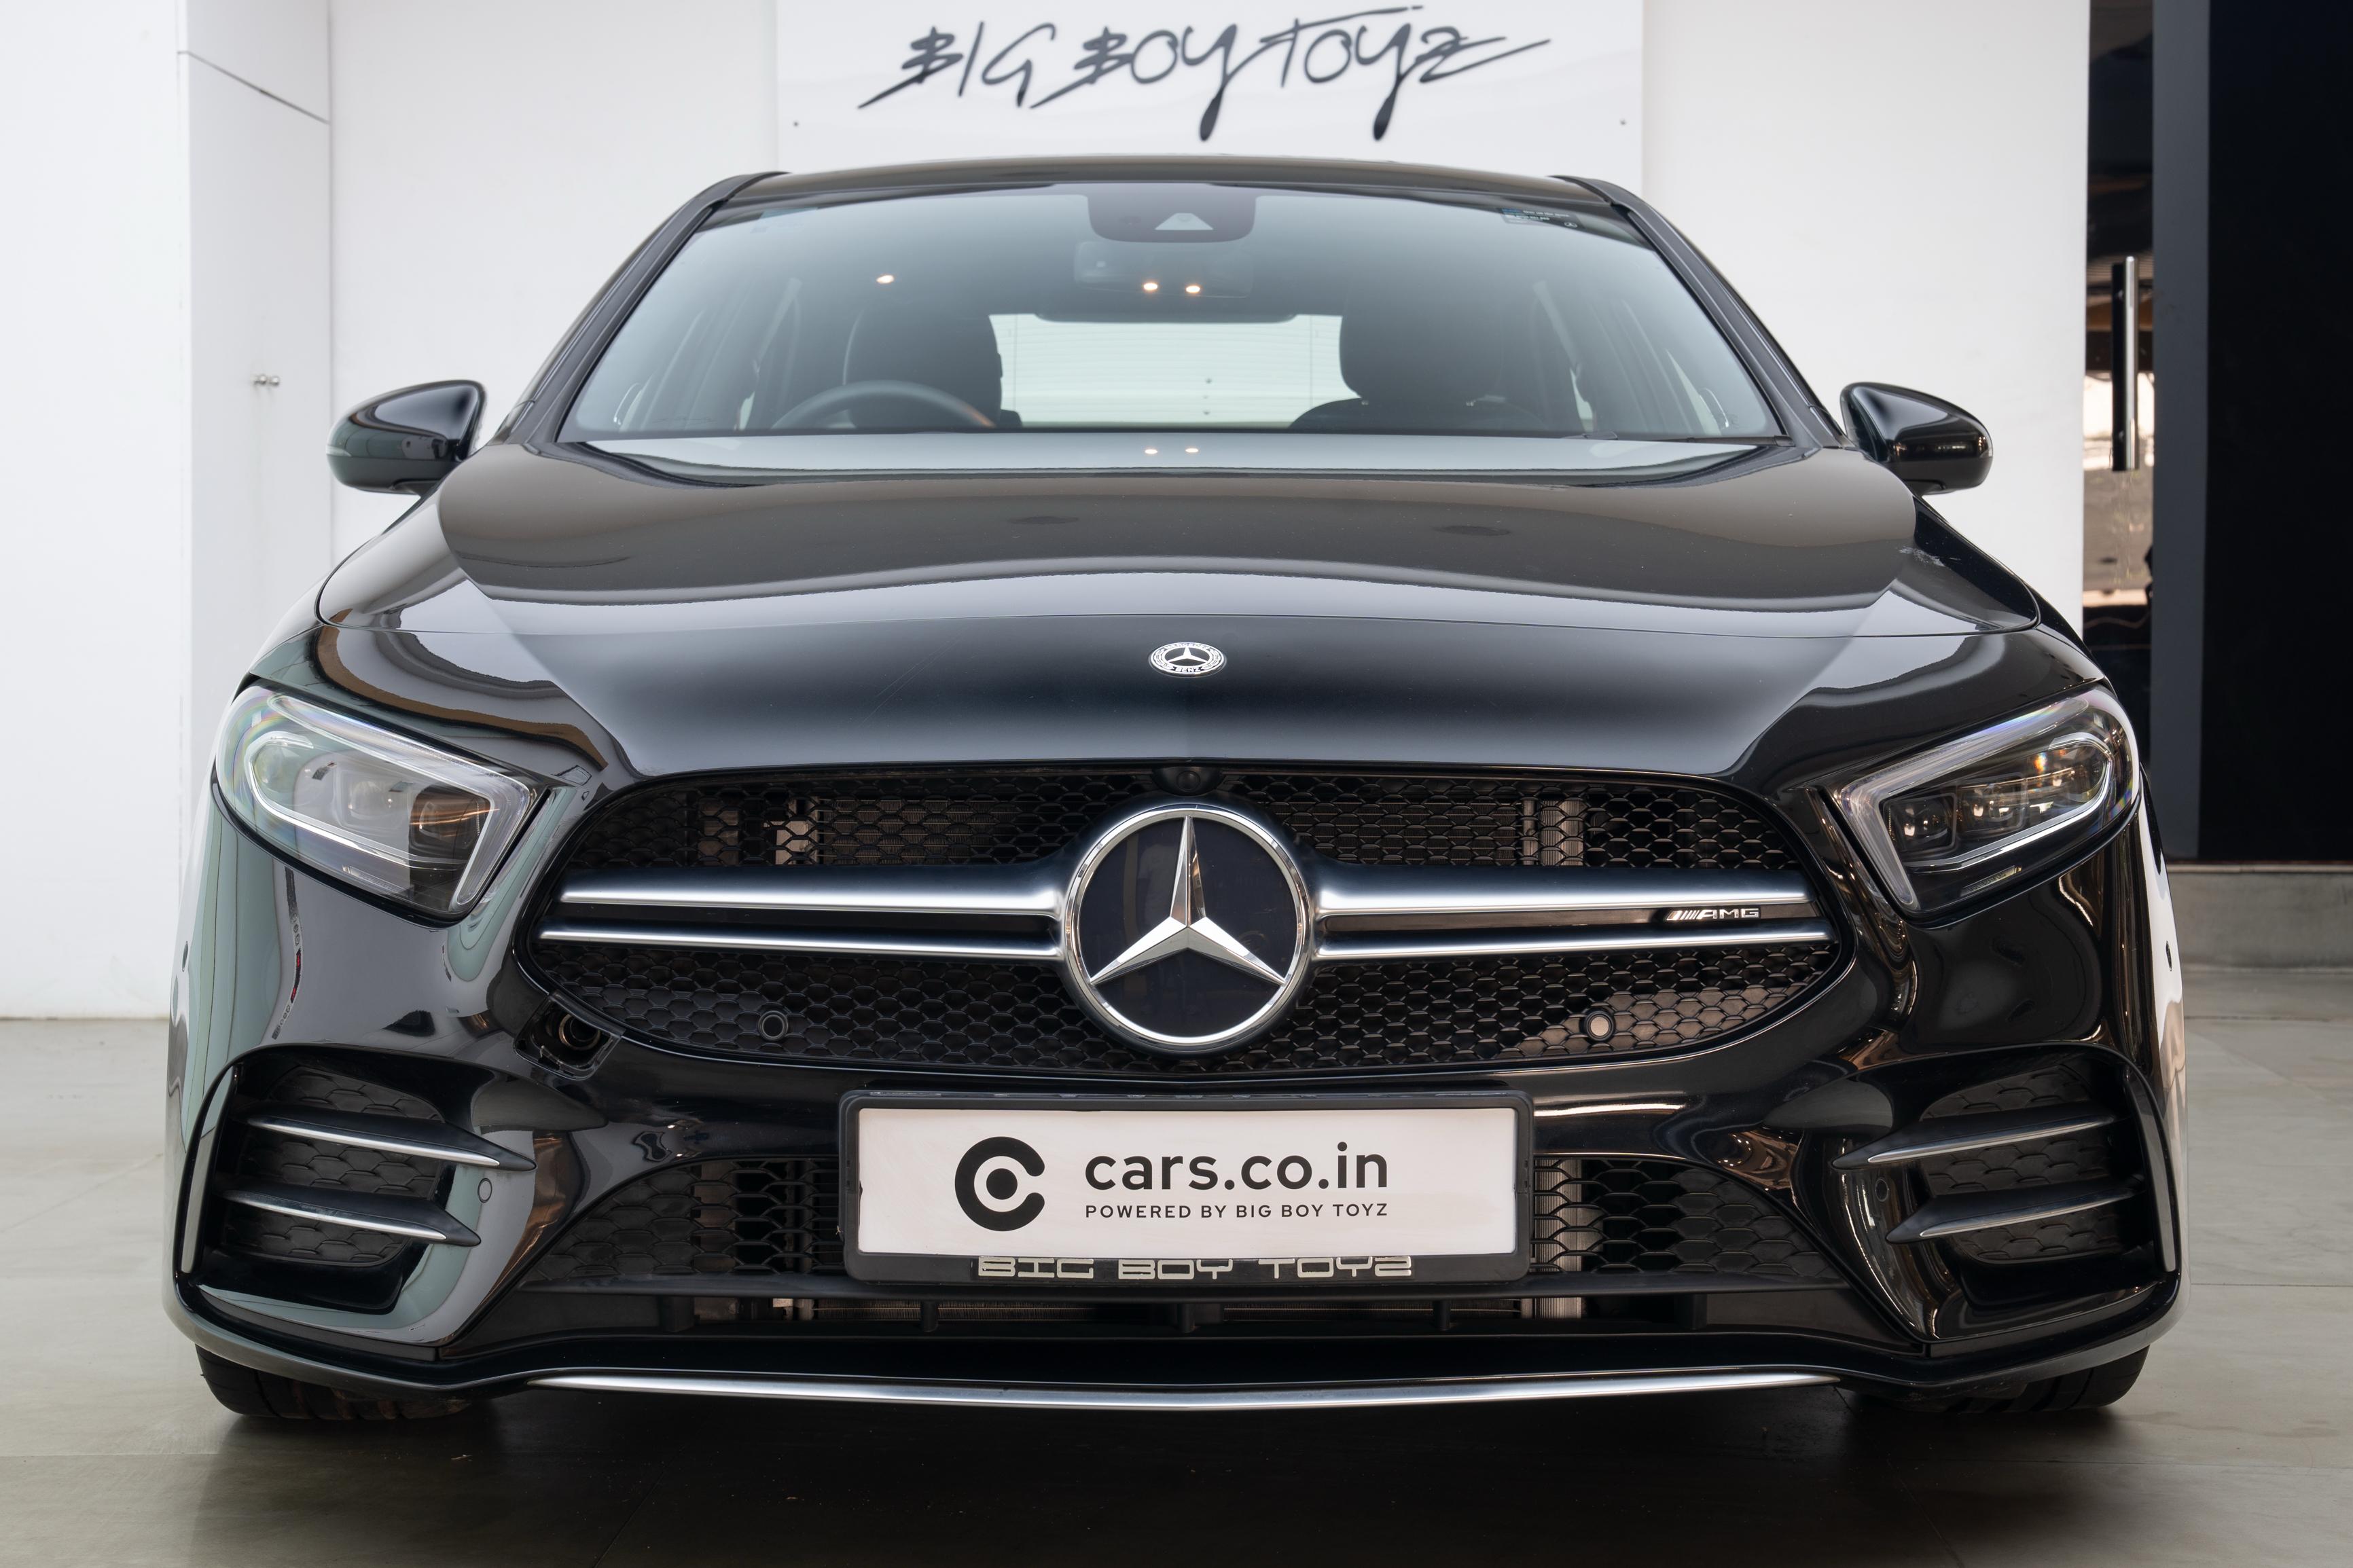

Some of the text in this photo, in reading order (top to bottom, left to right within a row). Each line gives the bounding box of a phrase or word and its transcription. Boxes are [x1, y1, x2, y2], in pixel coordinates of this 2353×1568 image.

[1085, 1141, 1387, 1190] cars.co.in
[1085, 1203, 1387, 1218] POWERED BY BIG BOY TOYZ
[978, 1256, 1094, 1279] BIG
[1118, 1258, 1234, 1280] BOY
